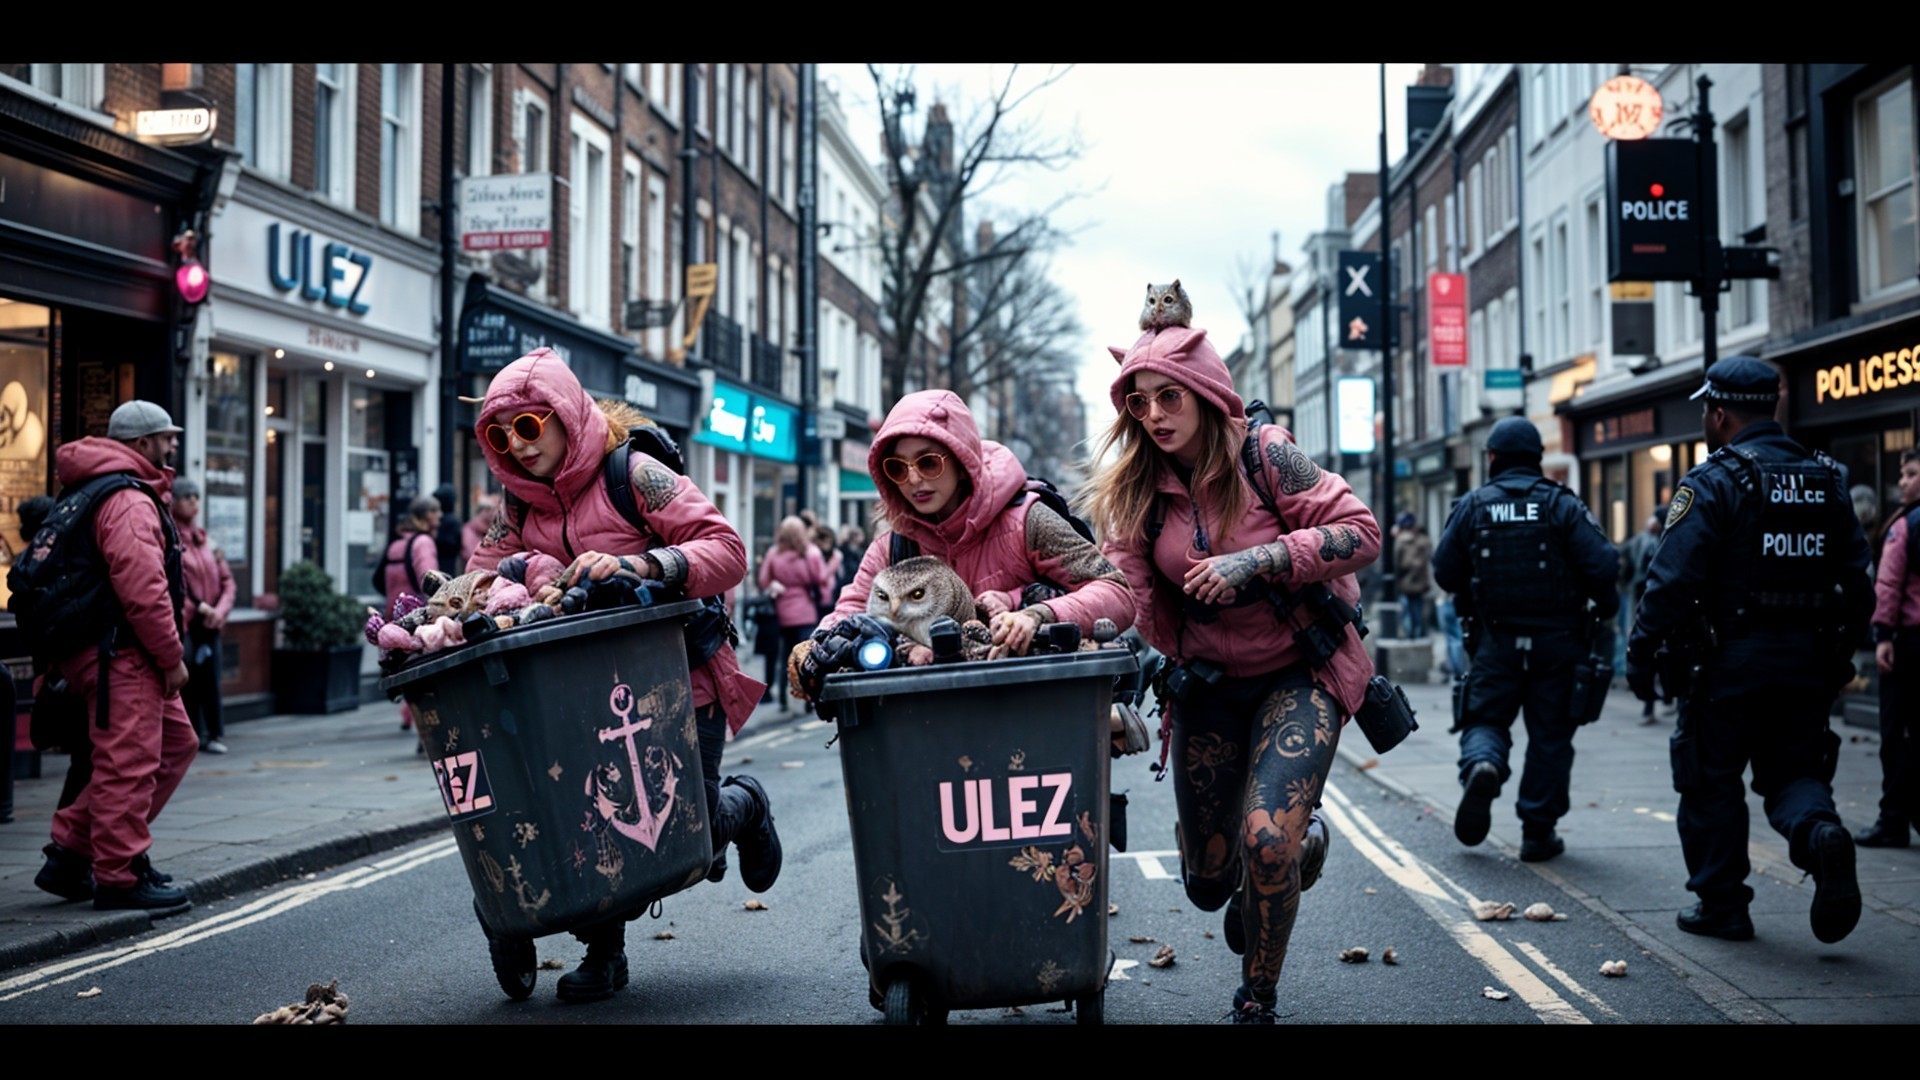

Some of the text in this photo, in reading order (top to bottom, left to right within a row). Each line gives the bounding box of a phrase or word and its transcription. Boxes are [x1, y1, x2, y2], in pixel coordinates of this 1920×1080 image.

[1622, 200, 1688, 220] POLICE
[268, 222, 372, 316] ULEZ
[1763, 533, 1825, 556] POLICE
[939, 773, 1072, 844] ULEZ
